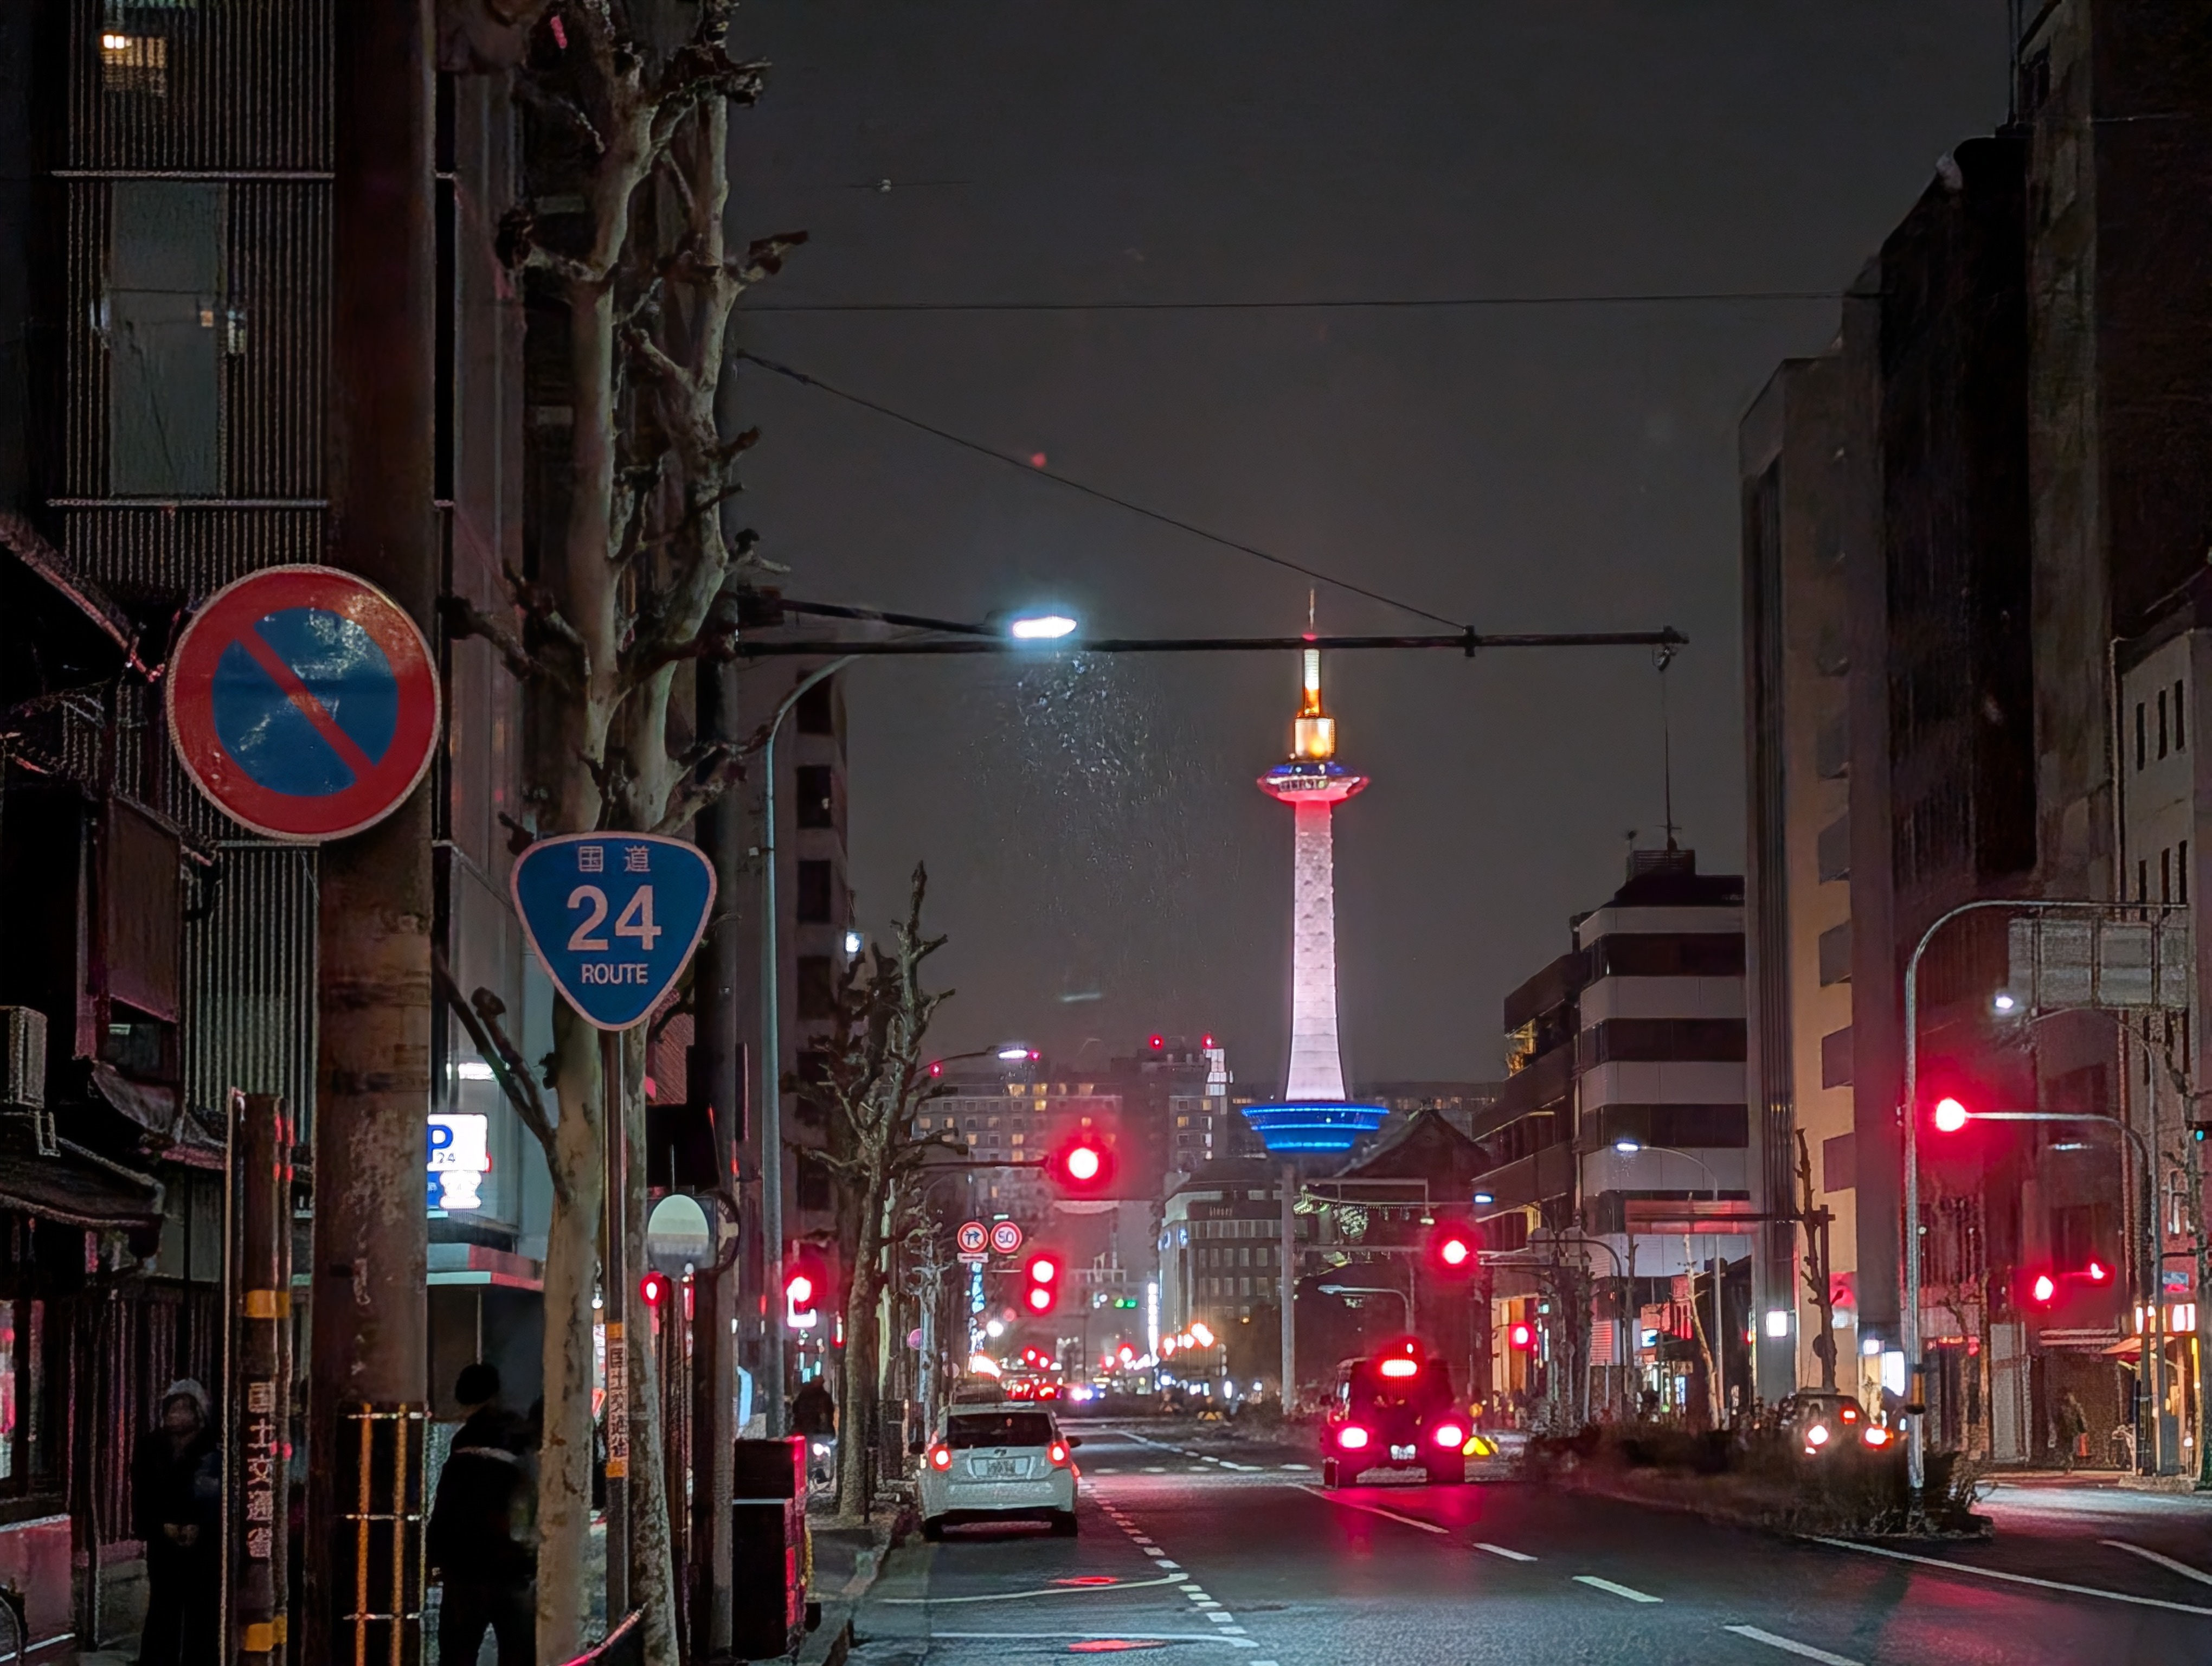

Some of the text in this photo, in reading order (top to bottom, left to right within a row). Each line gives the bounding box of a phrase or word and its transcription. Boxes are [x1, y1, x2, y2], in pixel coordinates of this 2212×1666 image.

[578, 845, 651, 872] 国道
[567, 885, 662, 951] 24
[581, 963, 649, 984] ROUTE
[427, 1124, 454, 1163] P
[436, 1152, 456, 1164] 24
[998, 1231, 1014, 1244] 50
[247, 1381, 276, 1558] 国土交通省
